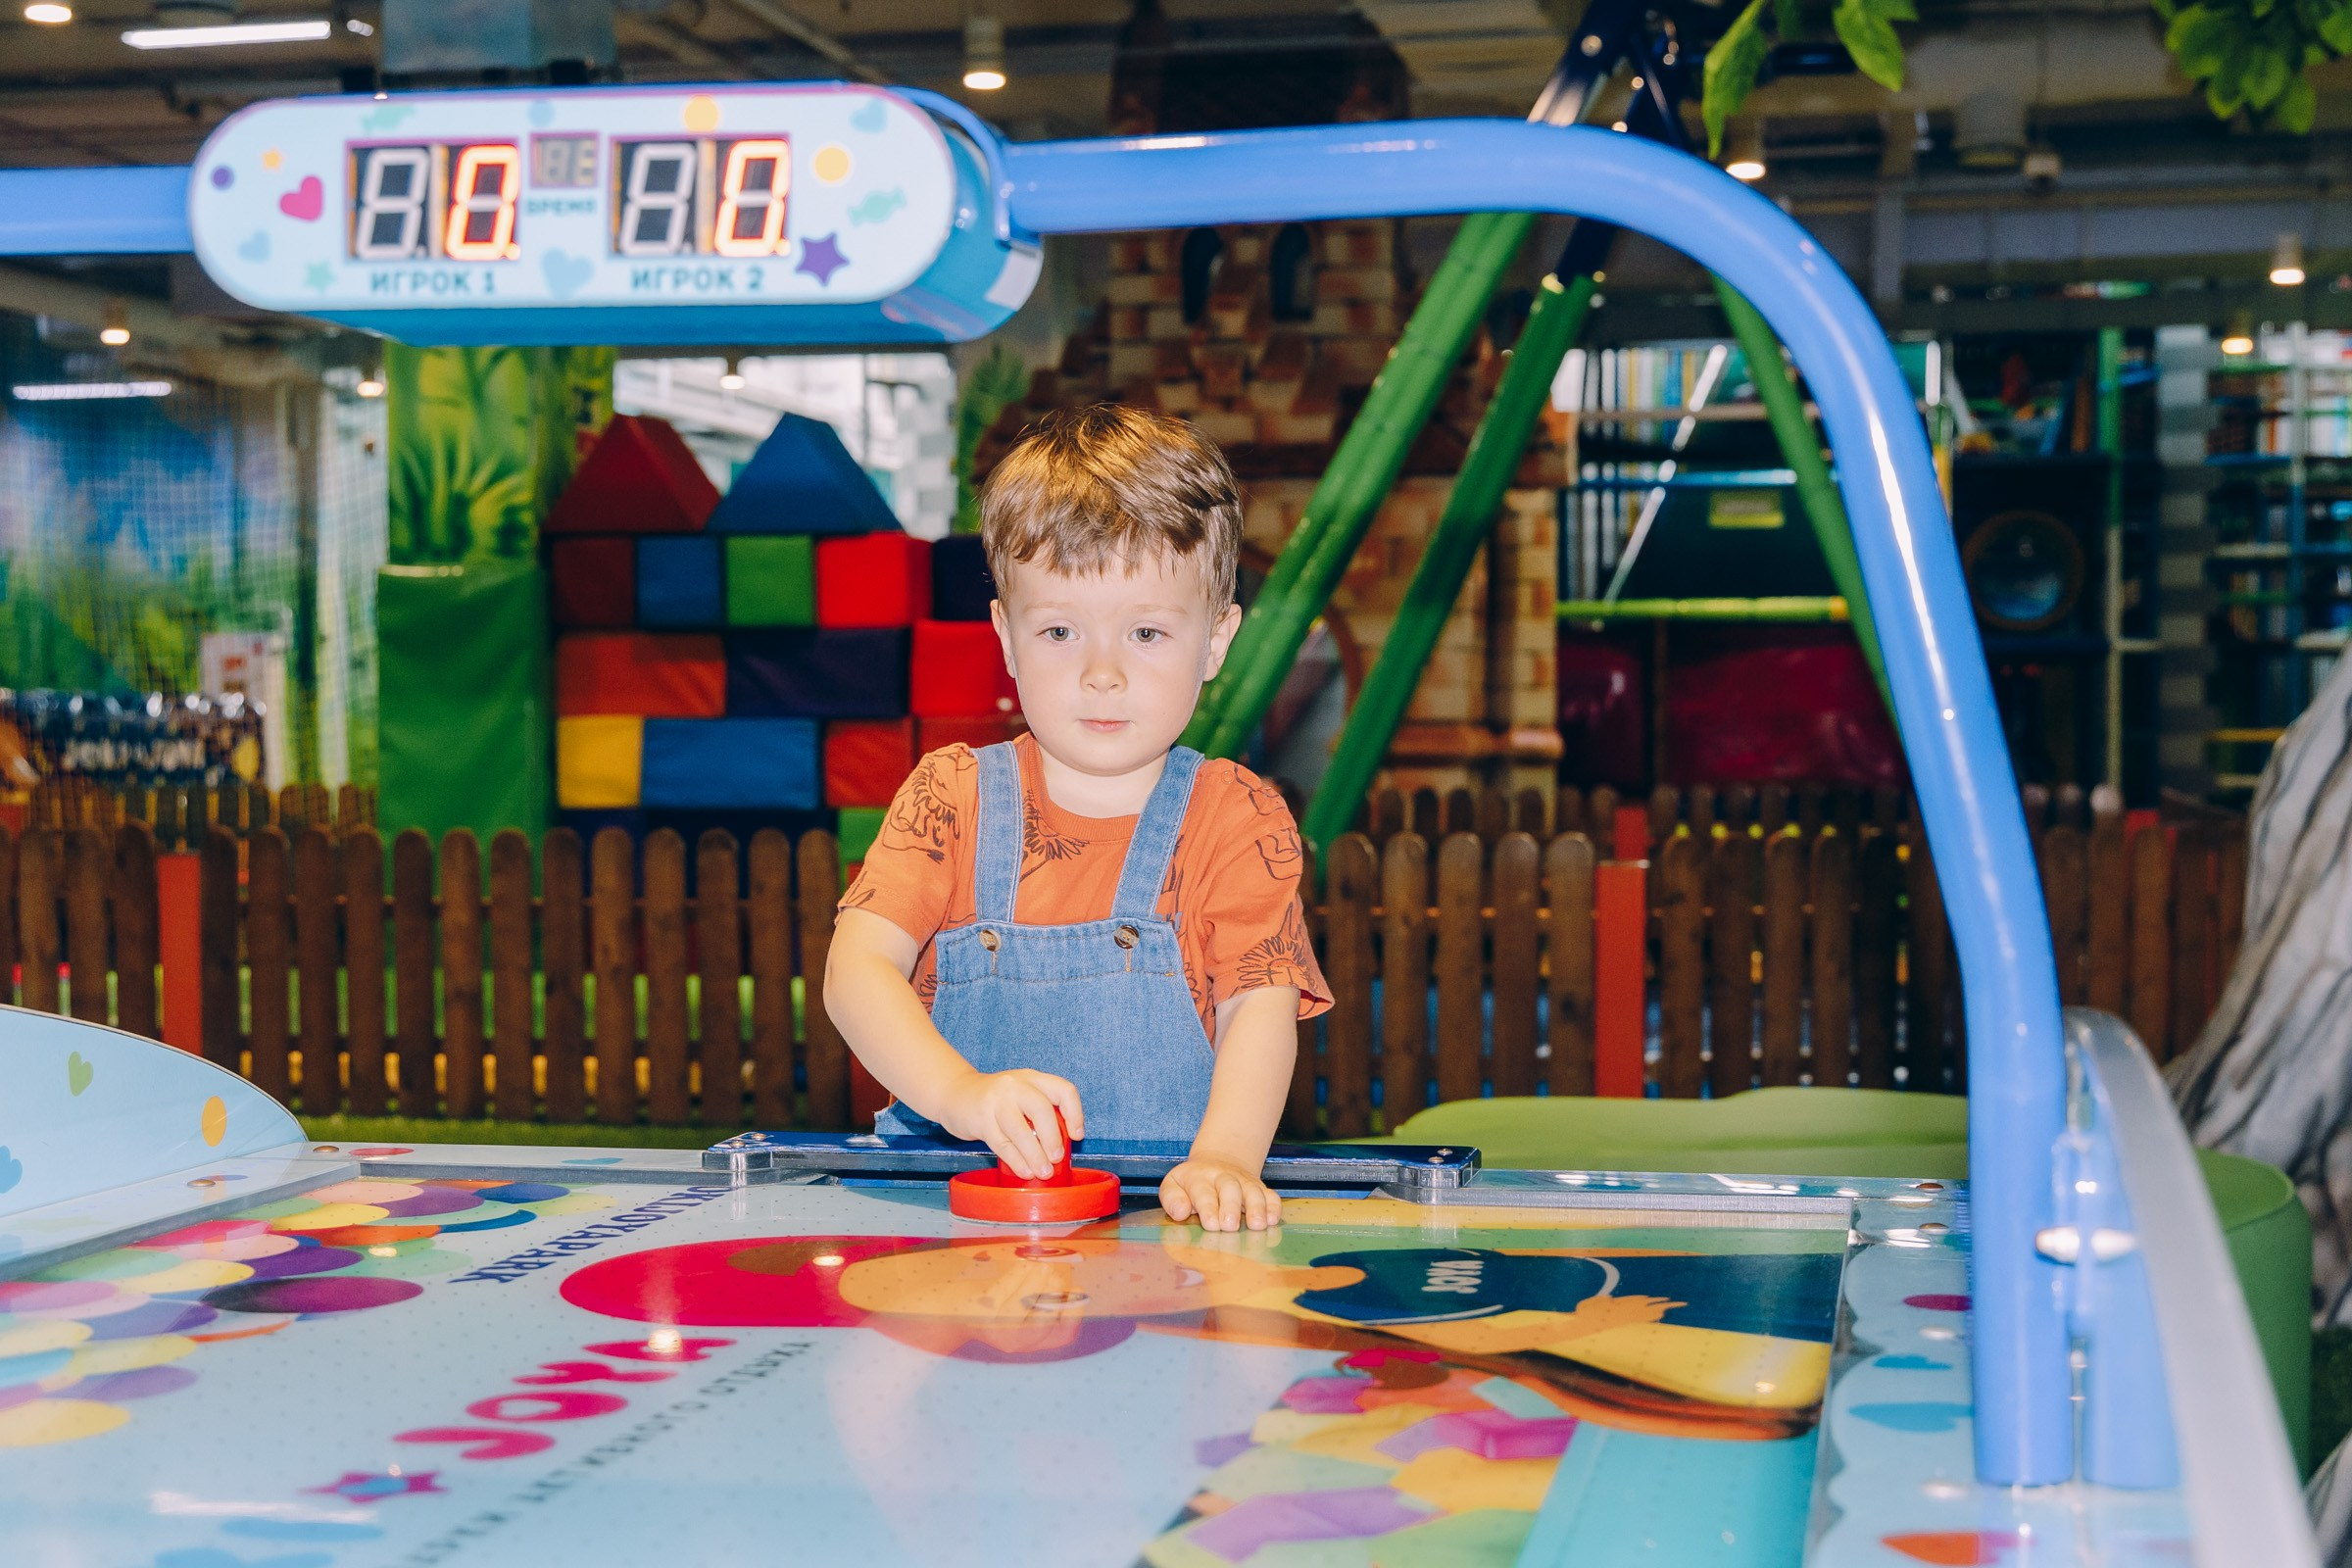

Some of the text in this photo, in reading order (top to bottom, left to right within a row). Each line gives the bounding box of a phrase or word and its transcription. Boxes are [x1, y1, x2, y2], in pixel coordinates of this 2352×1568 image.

[370, 270, 497, 293] ИГРОК 1
[631, 266, 764, 290] ИГРОК 2
[1421, 1260, 1485, 1294] JOYA
[392, 1337, 737, 1460] JOYA
